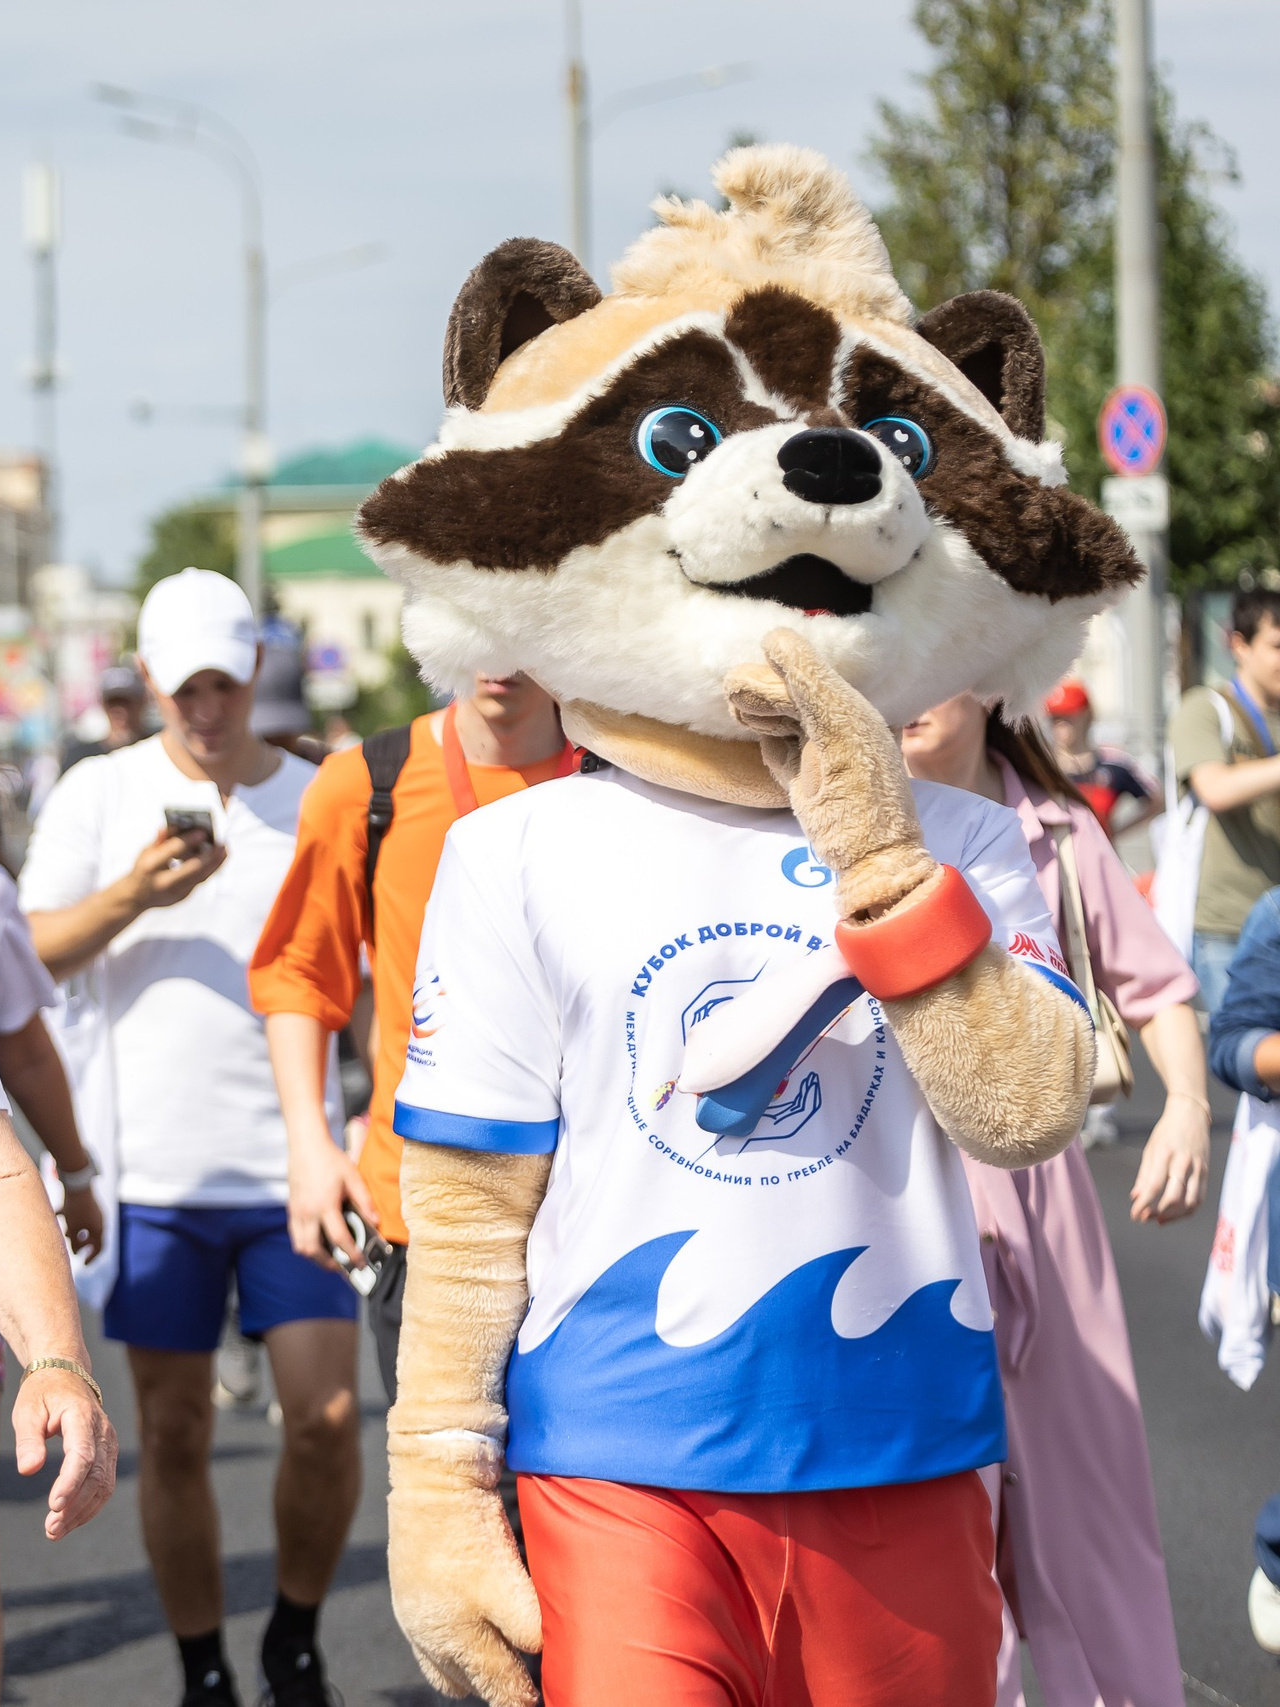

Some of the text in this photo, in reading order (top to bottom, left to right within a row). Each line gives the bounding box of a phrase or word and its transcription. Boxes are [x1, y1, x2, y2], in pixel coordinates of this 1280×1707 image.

[631, 933, 695, 997] КУБОК
[697, 922, 802, 944] ДОБРОЙ
[626, 998, 886, 1187] МЕЖДУНДНЫЕ СОРЕВНОВАНИЯ ПО ГРЕБЛЕ НА БАЙДАРКАХ И КАНОЭ
